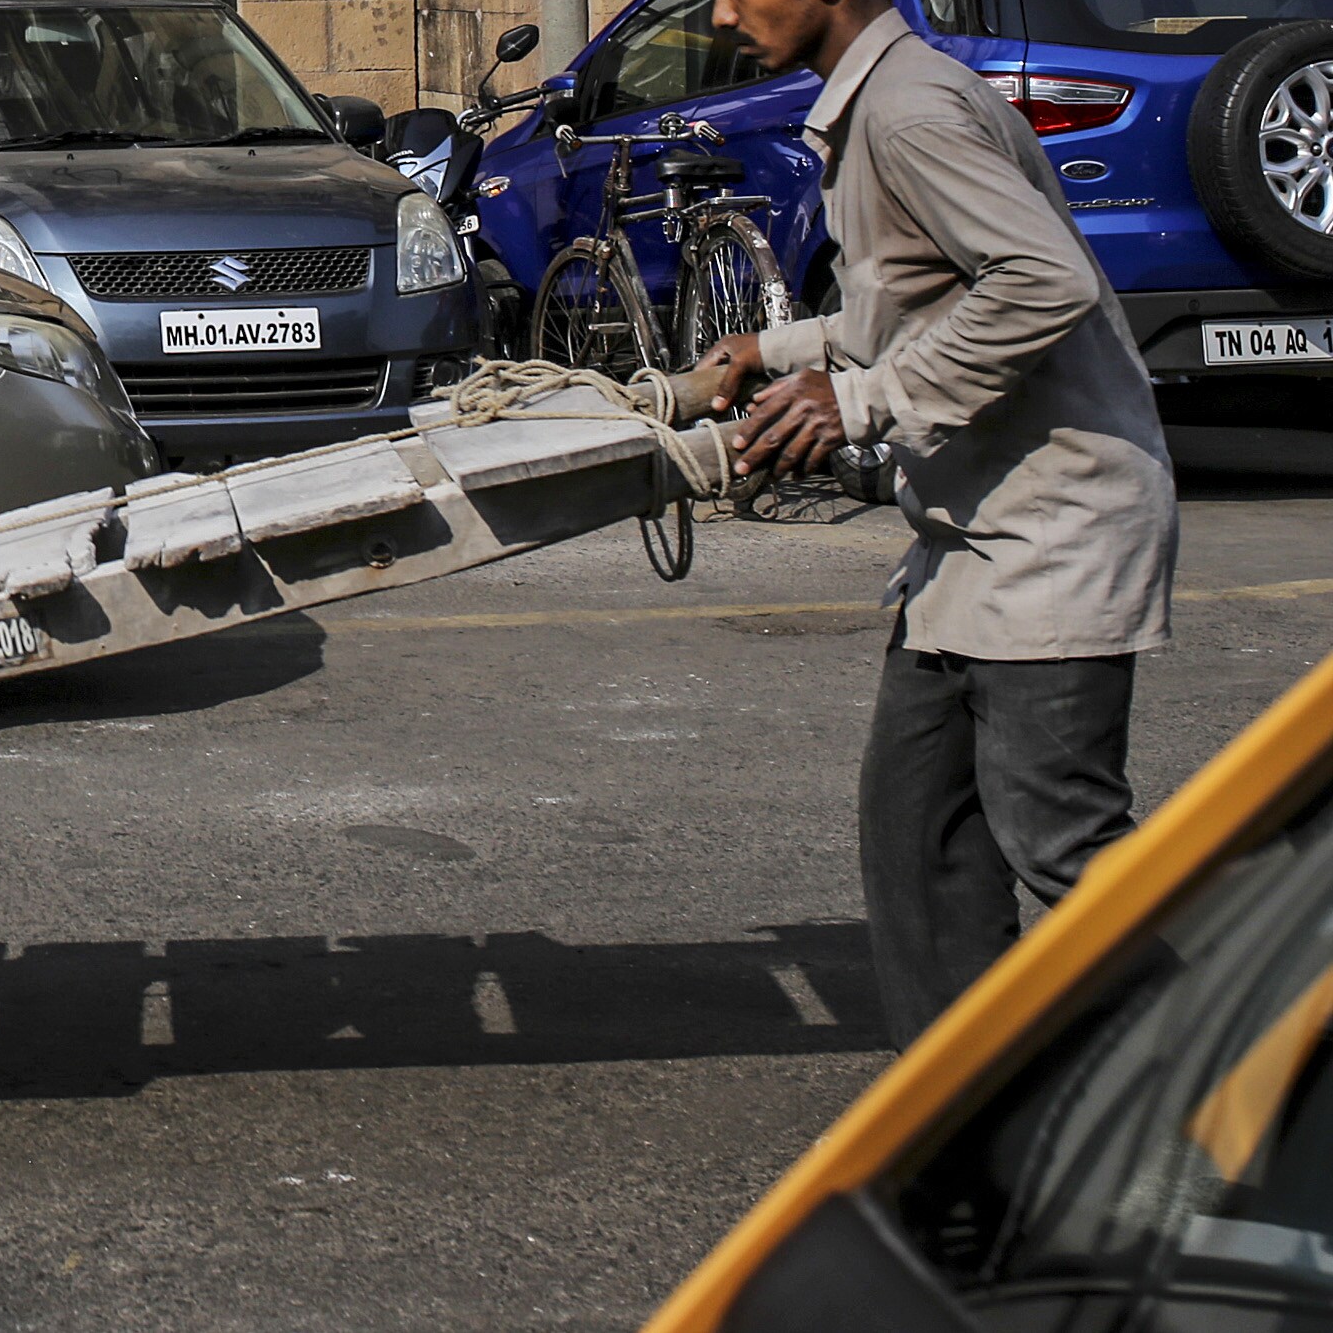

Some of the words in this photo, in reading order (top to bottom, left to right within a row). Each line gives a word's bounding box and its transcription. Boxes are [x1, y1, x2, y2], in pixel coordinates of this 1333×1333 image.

[166, 322, 316, 347] MH.01.AV.2783
[1215, 330, 1243, 357] TN
[1250, 329, 1277, 356] 04
[1285, 328, 1309, 355] AQ
